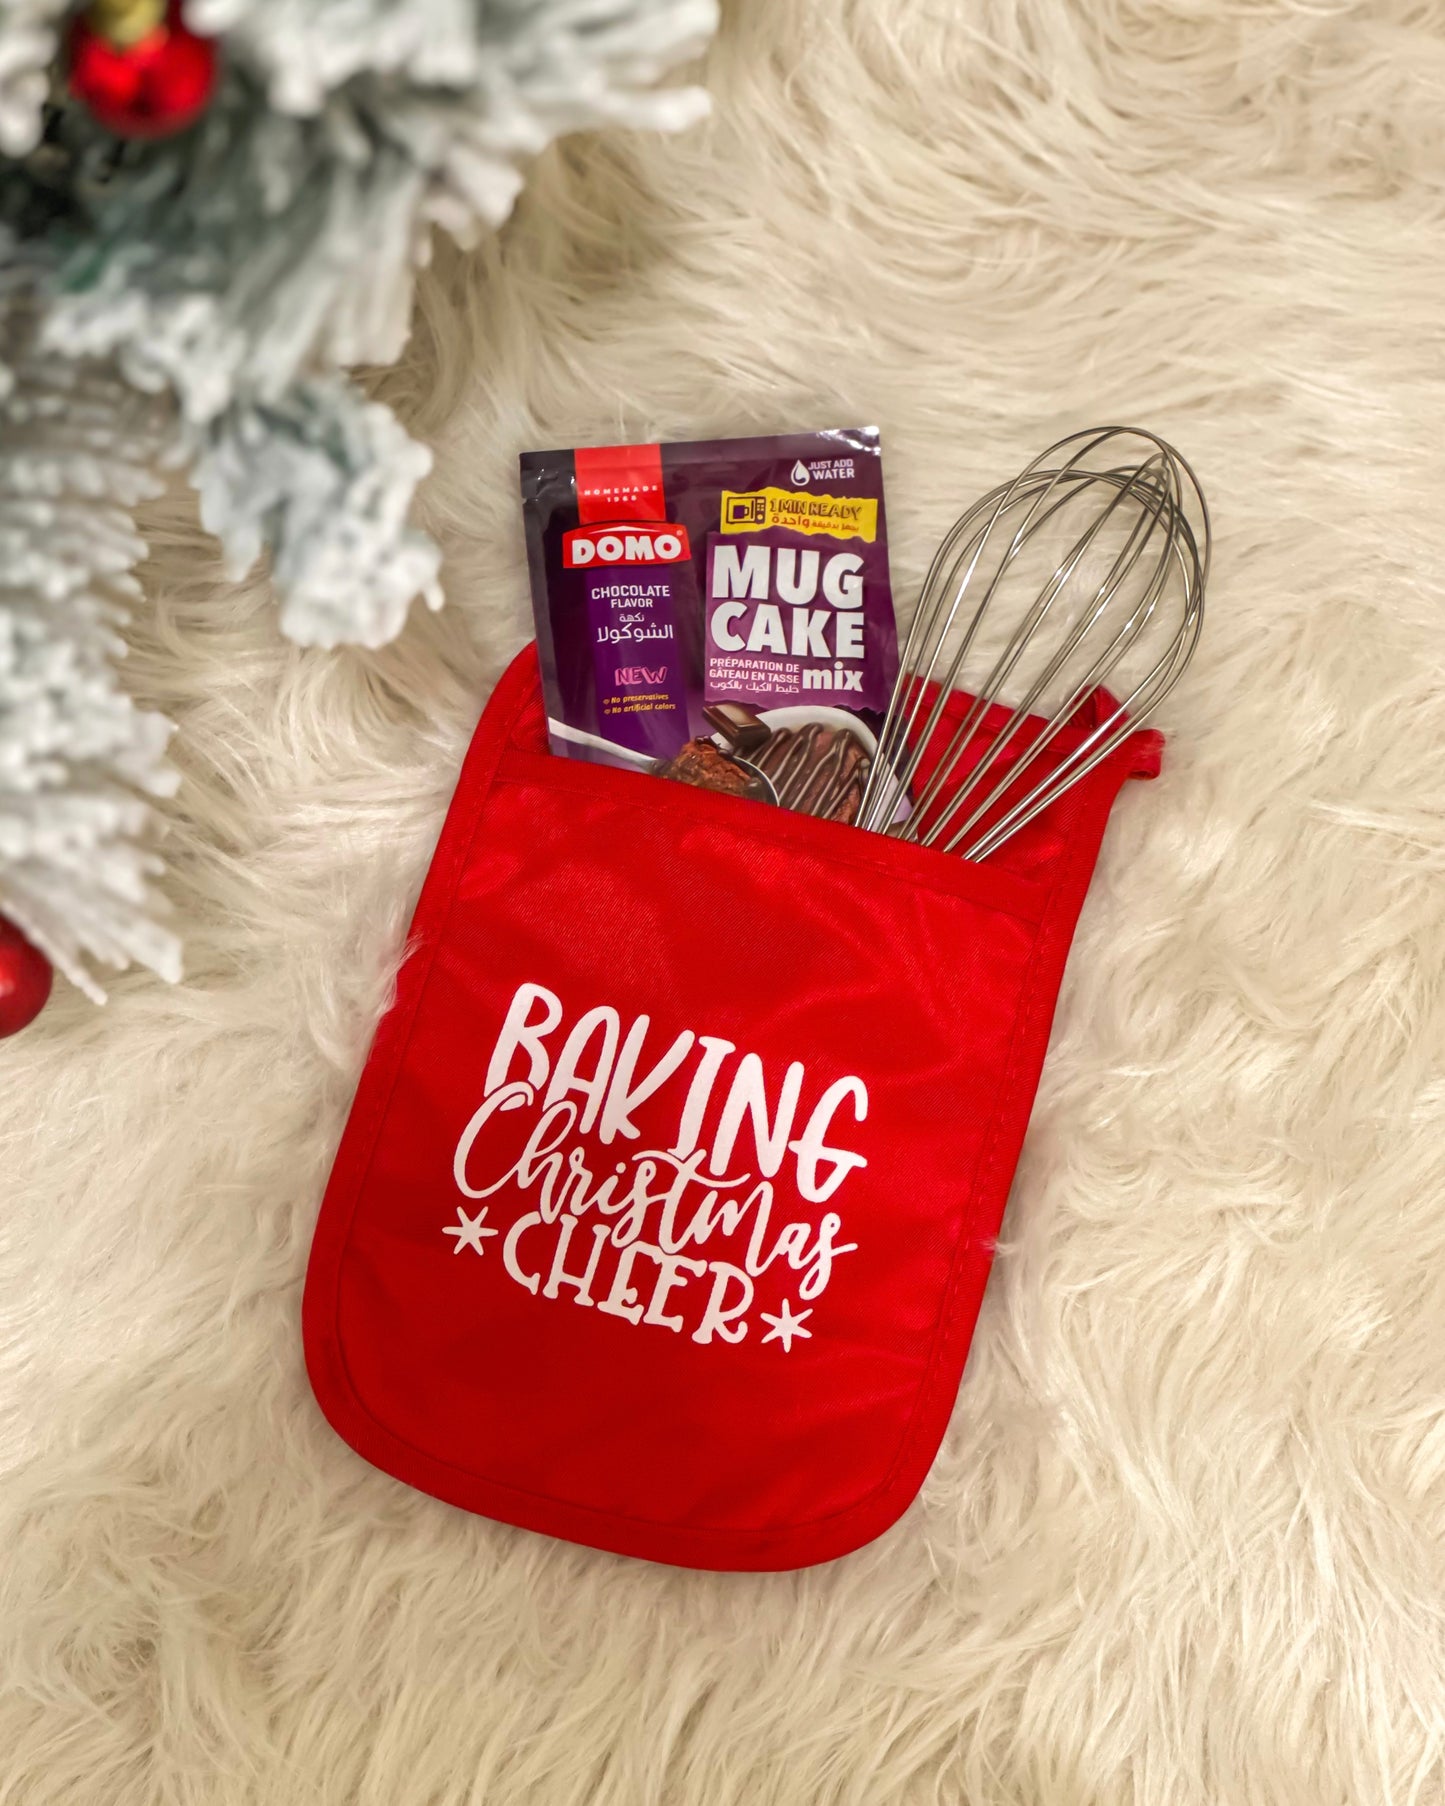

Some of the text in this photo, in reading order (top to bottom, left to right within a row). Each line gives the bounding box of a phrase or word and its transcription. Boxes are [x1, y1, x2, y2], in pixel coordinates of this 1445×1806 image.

[808, 458, 854, 471] JUST ADD
[812, 467, 855, 480] WATER
[583, 485, 658, 497] HOMEMADE
[769, 498, 862, 521] 1 MIN READY
[771, 513, 811, 529] واحدة
[572, 534, 682, 565] DOMO
[711, 544, 865, 609] MUG
[591, 584, 671, 600] CHOCOLATE
[610, 598, 653, 609] FLAVOR
[619, 612, 645, 623] نكهة
[596, 622, 674, 644] الشوكولا
[709, 601, 865, 659] CAKE
[709, 656, 800, 673] PRÉPARATION DE
[614, 665, 668, 686] NEW
[709, 667, 800, 684] GÂTEAU EN TASSE
[802, 661, 864, 692] mix
[611, 692, 669, 704] No preservatives
[612, 702, 676, 714] No artificial colors
[483, 982, 869, 1203] BAKING
[453, 1081, 858, 1301] Christmas
[502, 1211, 755, 1344] CHEER
